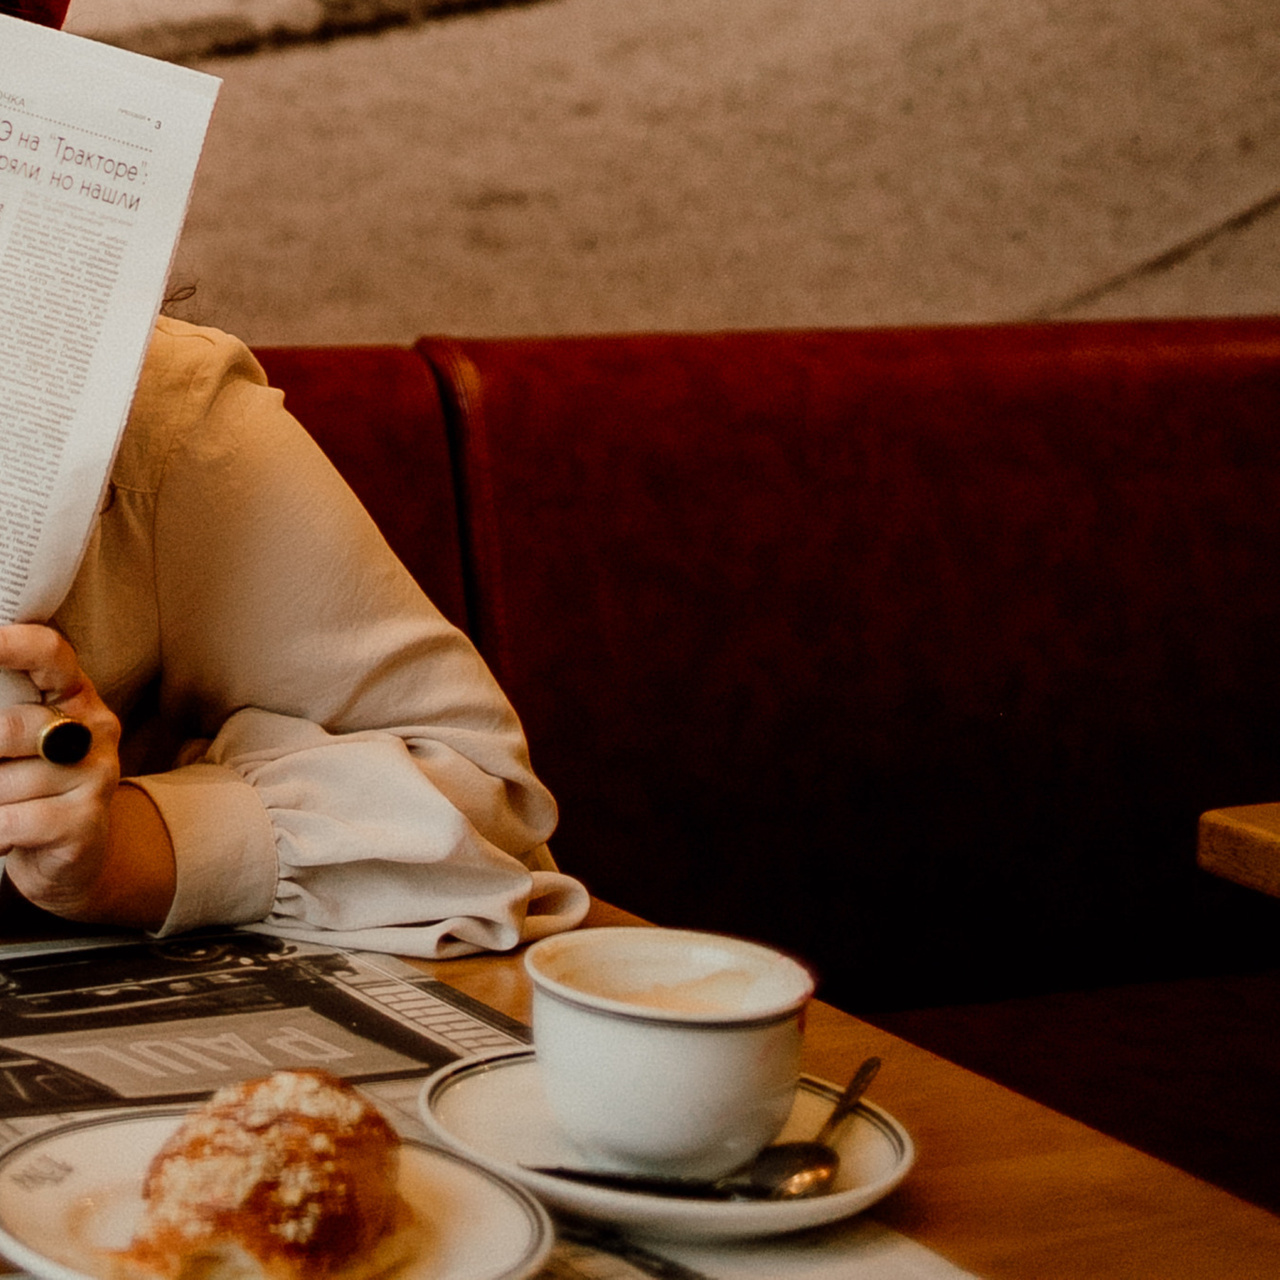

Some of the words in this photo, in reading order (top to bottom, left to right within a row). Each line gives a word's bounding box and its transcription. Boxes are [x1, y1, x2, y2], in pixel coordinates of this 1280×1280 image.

[153, 119, 163, 130] 3
[16, 130, 42, 153] на
[48, 170, 75, 192] но
[77, 178, 142, 213] нашли
[61, 1026, 355, 1078] PAUL
